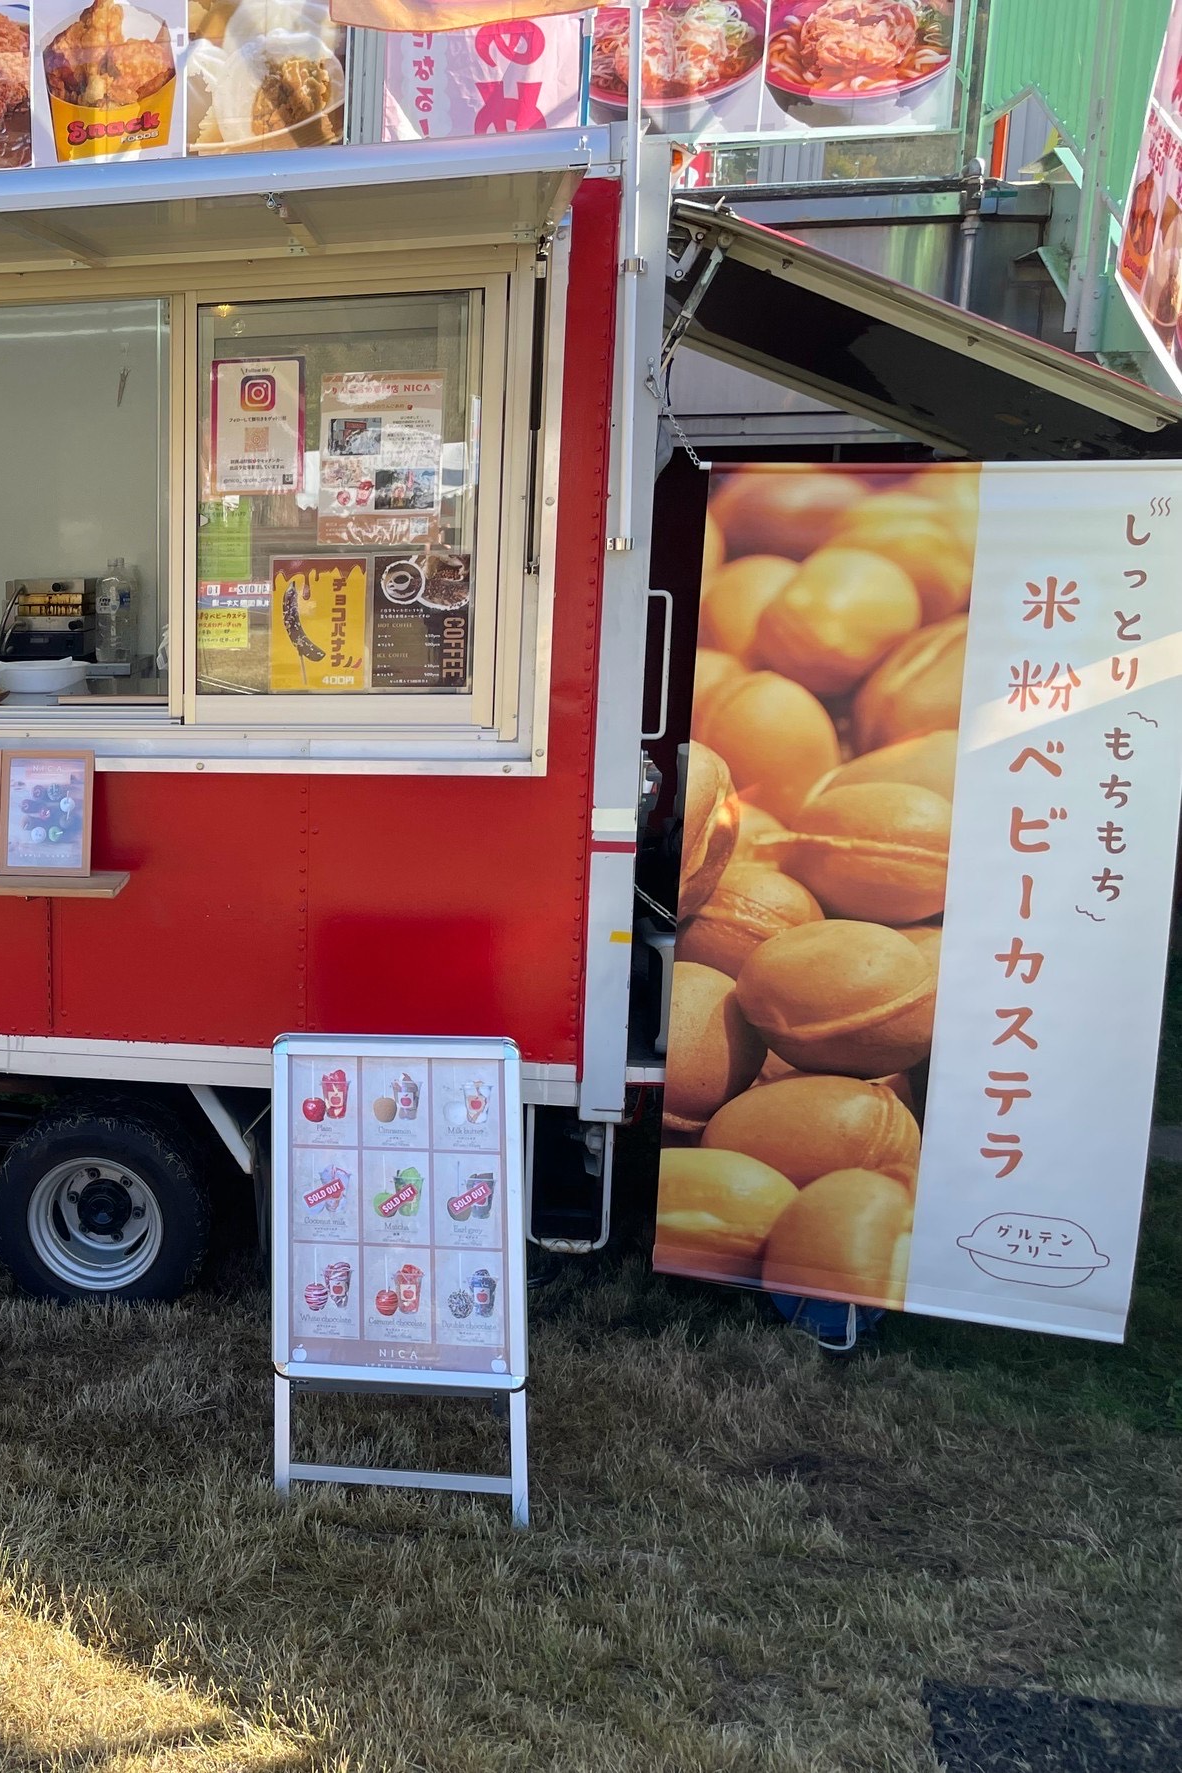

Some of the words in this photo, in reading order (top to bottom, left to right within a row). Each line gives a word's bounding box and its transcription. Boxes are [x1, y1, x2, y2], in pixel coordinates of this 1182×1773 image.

[67, 111, 161, 146] Snack
[403, 384, 431, 392] NICA
[1110, 514, 1151, 690] しっとり
[330, 577, 348, 668] チョコバナナ
[442, 617, 466, 679] COFFEE
[322, 676, 355, 685] 400円
[1091, 726, 1135, 903] もちもち
[979, 575, 1081, 1182] 米粉ベビーカステラ
[307, 1189, 326, 1205] SOLD
[324, 1182, 341, 1197] OUT
[381, 1195, 400, 1214] SOLD
[399, 1187, 415, 1202] OUT
[452, 1193, 472, 1211] SOLD
[471, 1185, 488, 1199] OUT
[384, 1222, 410, 1231] Matcha
[997, 1225, 1073, 1246] グルテン
[1007, 1244, 1062, 1259] フリー
[378, 1348, 418, 1360] NICA
